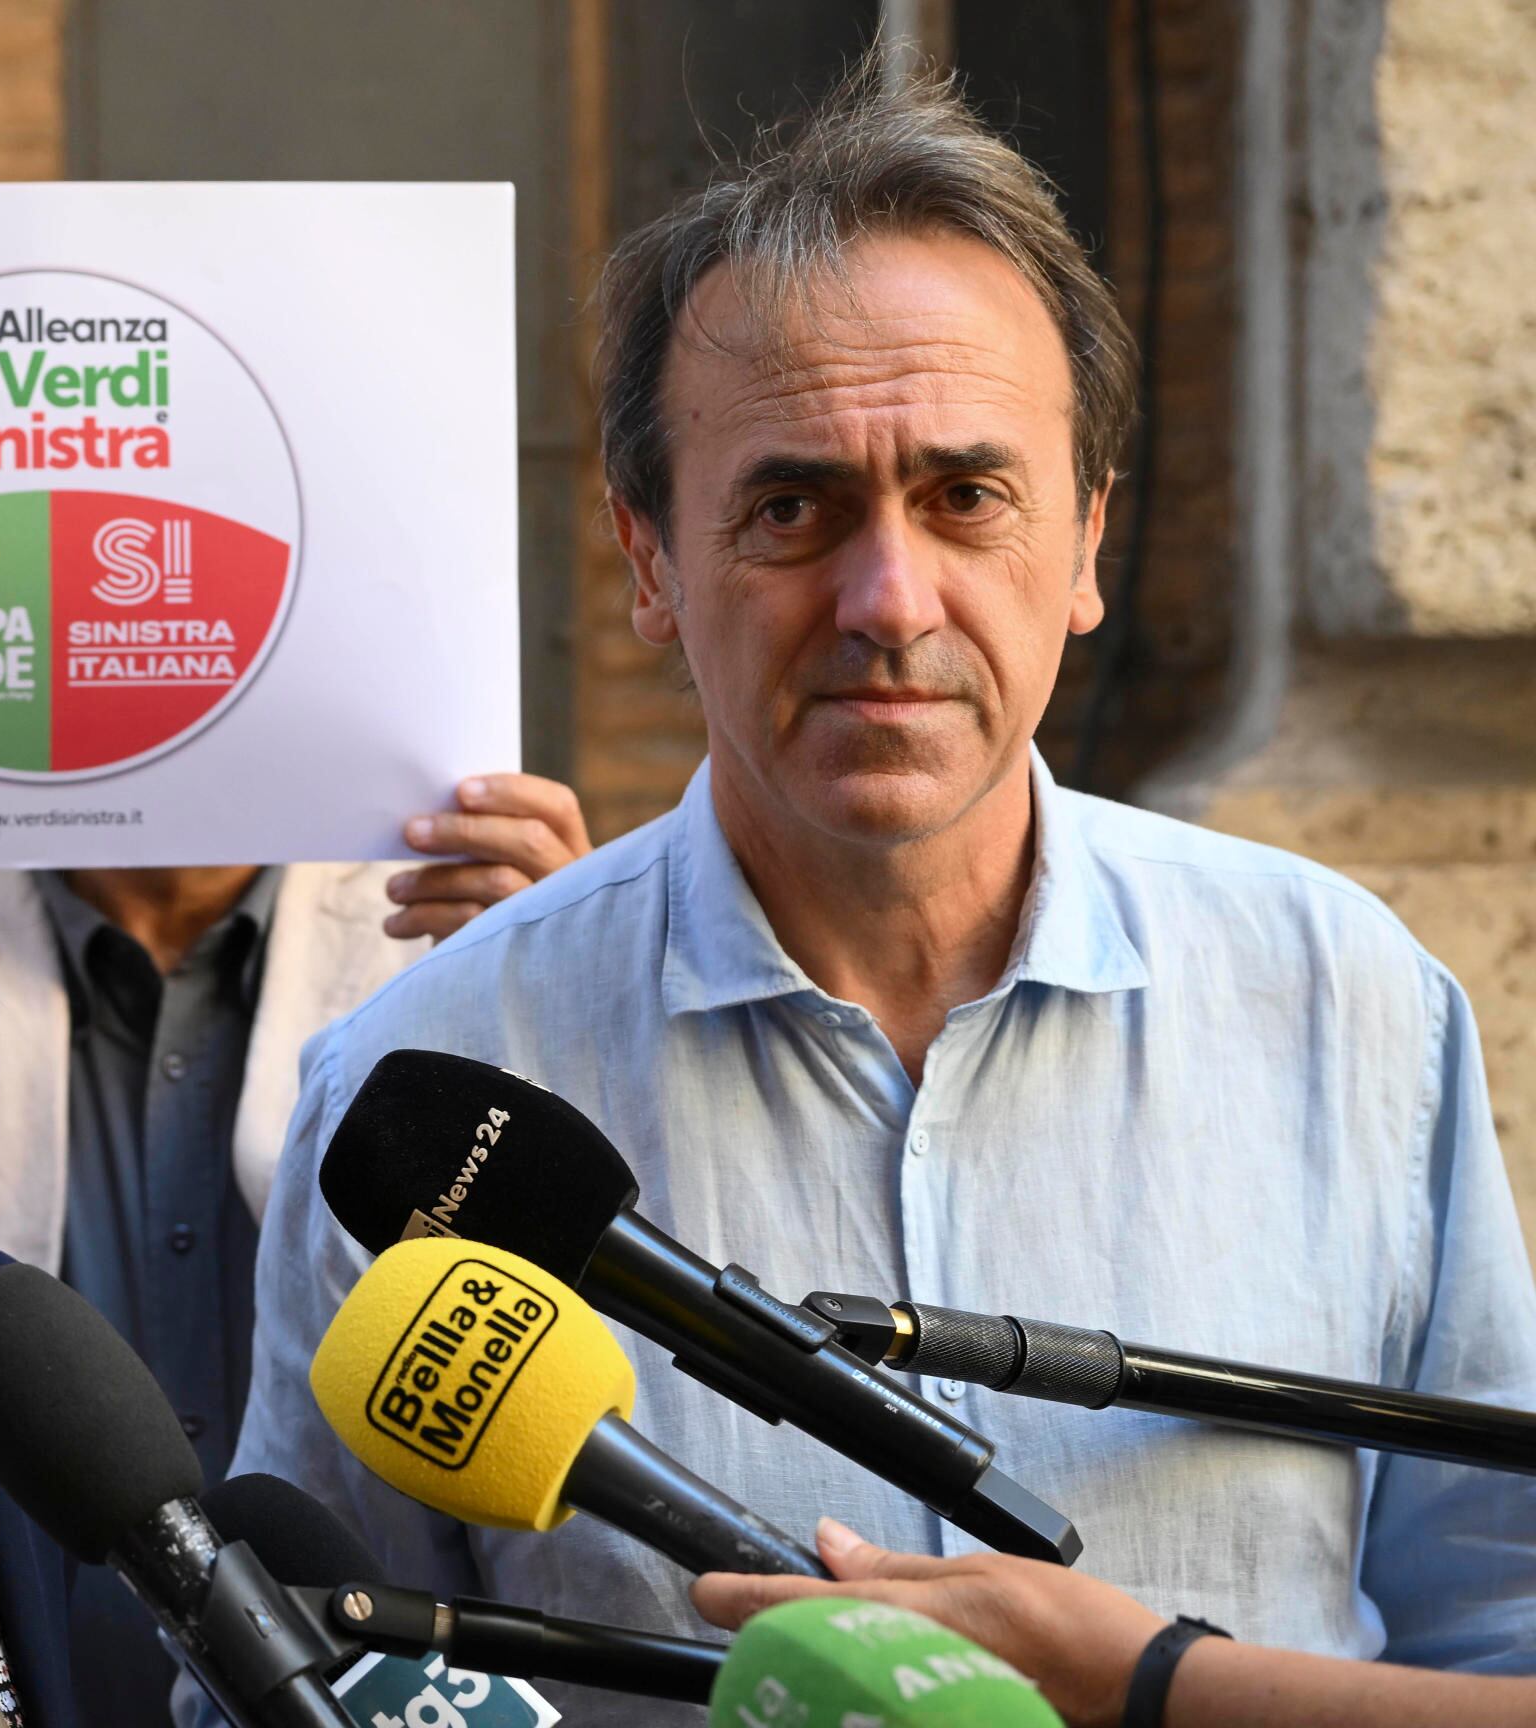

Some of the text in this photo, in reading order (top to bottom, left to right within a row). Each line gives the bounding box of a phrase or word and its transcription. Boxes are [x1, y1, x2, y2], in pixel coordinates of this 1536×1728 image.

[156, 410, 168, 424] e
[68, 620, 234, 645] SINISTRA
[68, 654, 235, 678] ITALIANA
[431, 1107, 511, 1224] News 24
[462, 1279, 503, 1305] &
[419, 1299, 543, 1456] Monella
[870, 1381, 943, 1429] SENNHEISER
[884, 1403, 899, 1414] AVX
